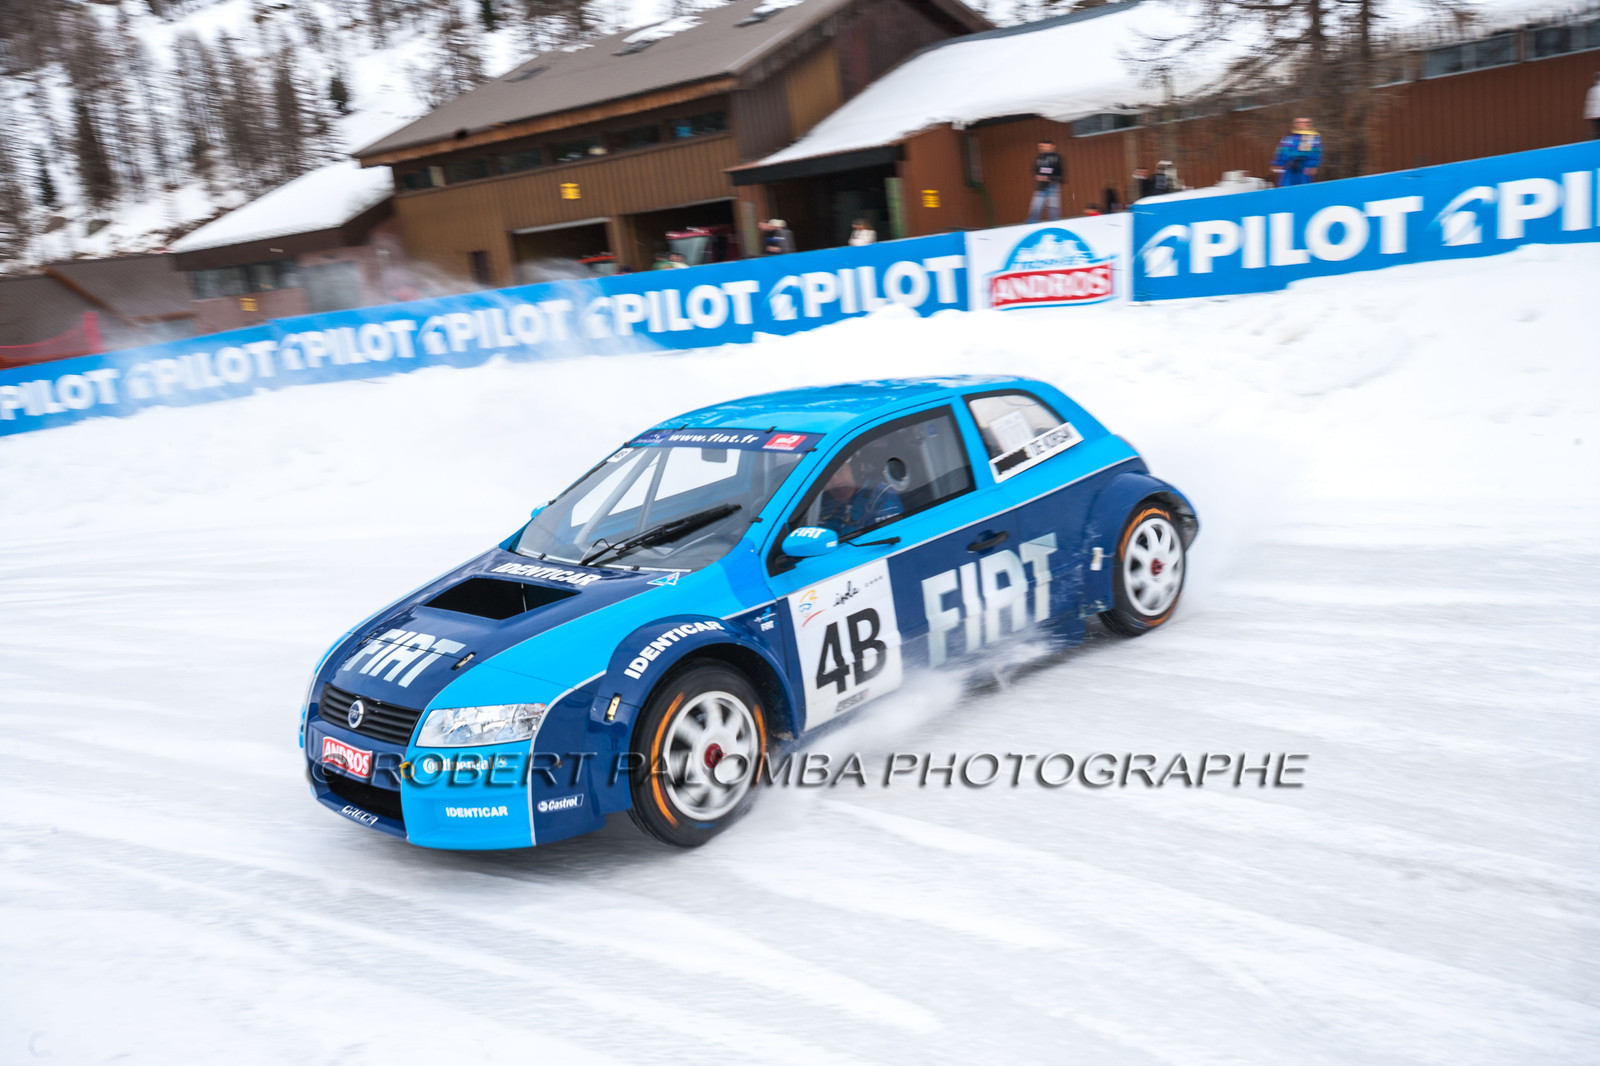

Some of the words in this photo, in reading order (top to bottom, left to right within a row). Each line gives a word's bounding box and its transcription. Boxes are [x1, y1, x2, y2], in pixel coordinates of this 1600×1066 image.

[1188, 195, 1423, 274] PILOT
[613, 279, 760, 335] PILOT
[801, 255, 966, 318] PILOT
[993, 268, 1110, 303] ANDROS
[300, 319, 417, 368] PILOT
[445, 299, 573, 352] PILOT
[152, 340, 279, 394] PILOT
[0, 368, 120, 421] PILOT
[668, 433, 759, 444] www.fiat.fr
[790, 527, 826, 539] FIAT
[491, 562, 602, 586] IDENTICAR
[921, 532, 1058, 668] FIAT
[342, 628, 467, 688] FIAT
[624, 620, 726, 680] IDENTICAR
[816, 608, 887, 694] 4B
[323, 741, 371, 776] ANDROS
[446, 806, 508, 818] IDENTICAR
[548, 797, 578, 809] Castrol
